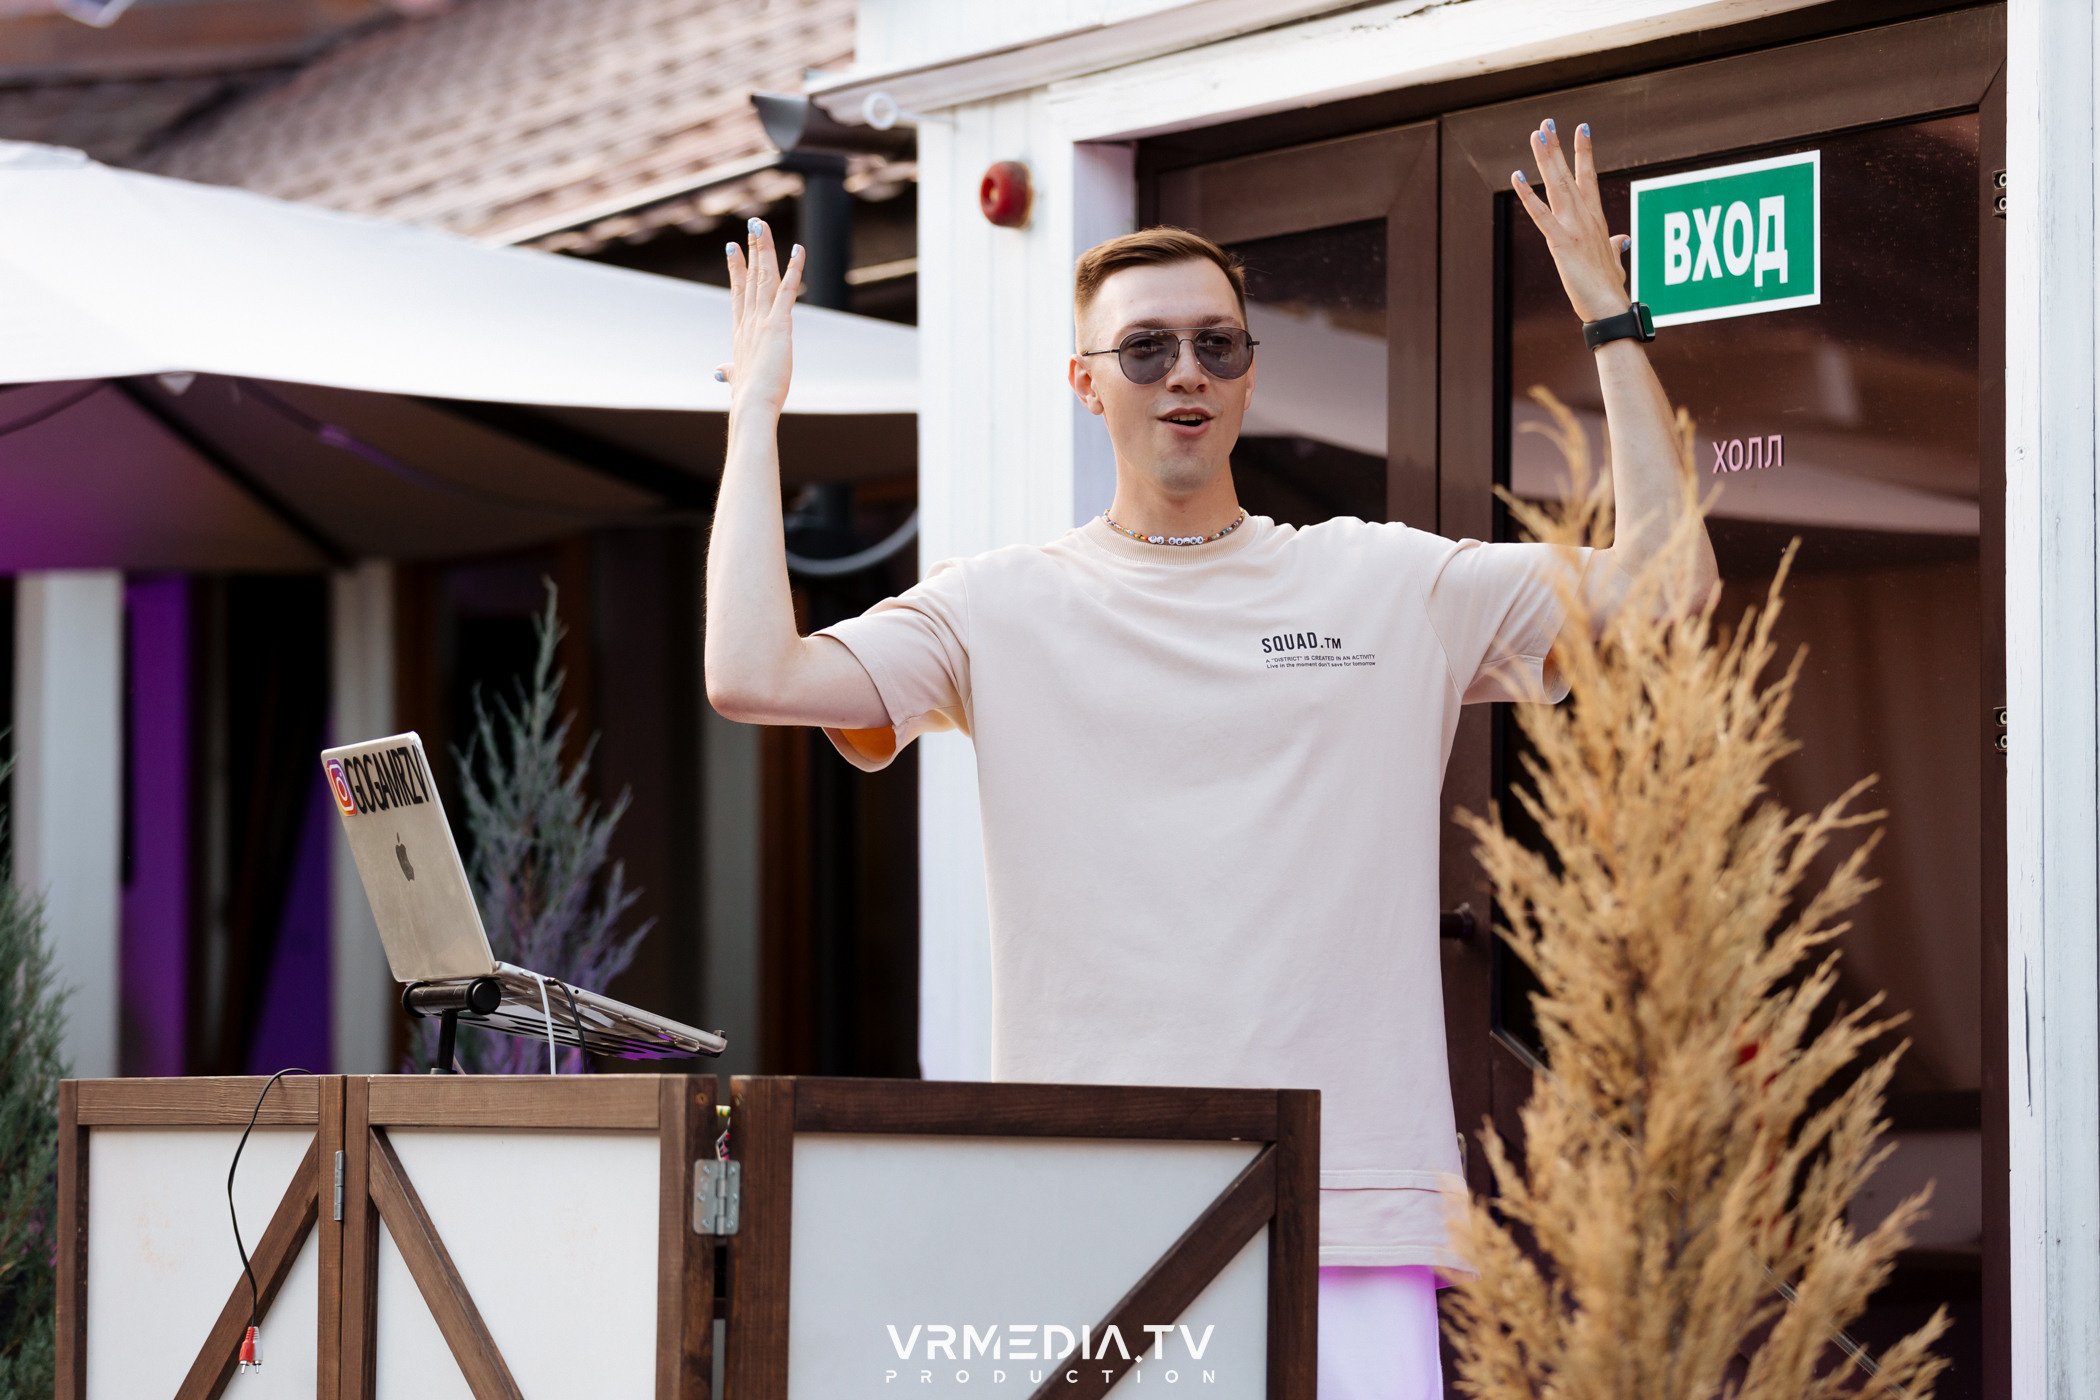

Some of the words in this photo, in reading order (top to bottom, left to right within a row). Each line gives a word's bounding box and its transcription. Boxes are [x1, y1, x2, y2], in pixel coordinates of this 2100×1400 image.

[1664, 194, 1789, 288] ВХОД
[1712, 434, 1783, 474] ХОЛЛ
[1261, 632, 1342, 653] SQUAD.TM
[1271, 655, 1303, 663] "DISTRICT"
